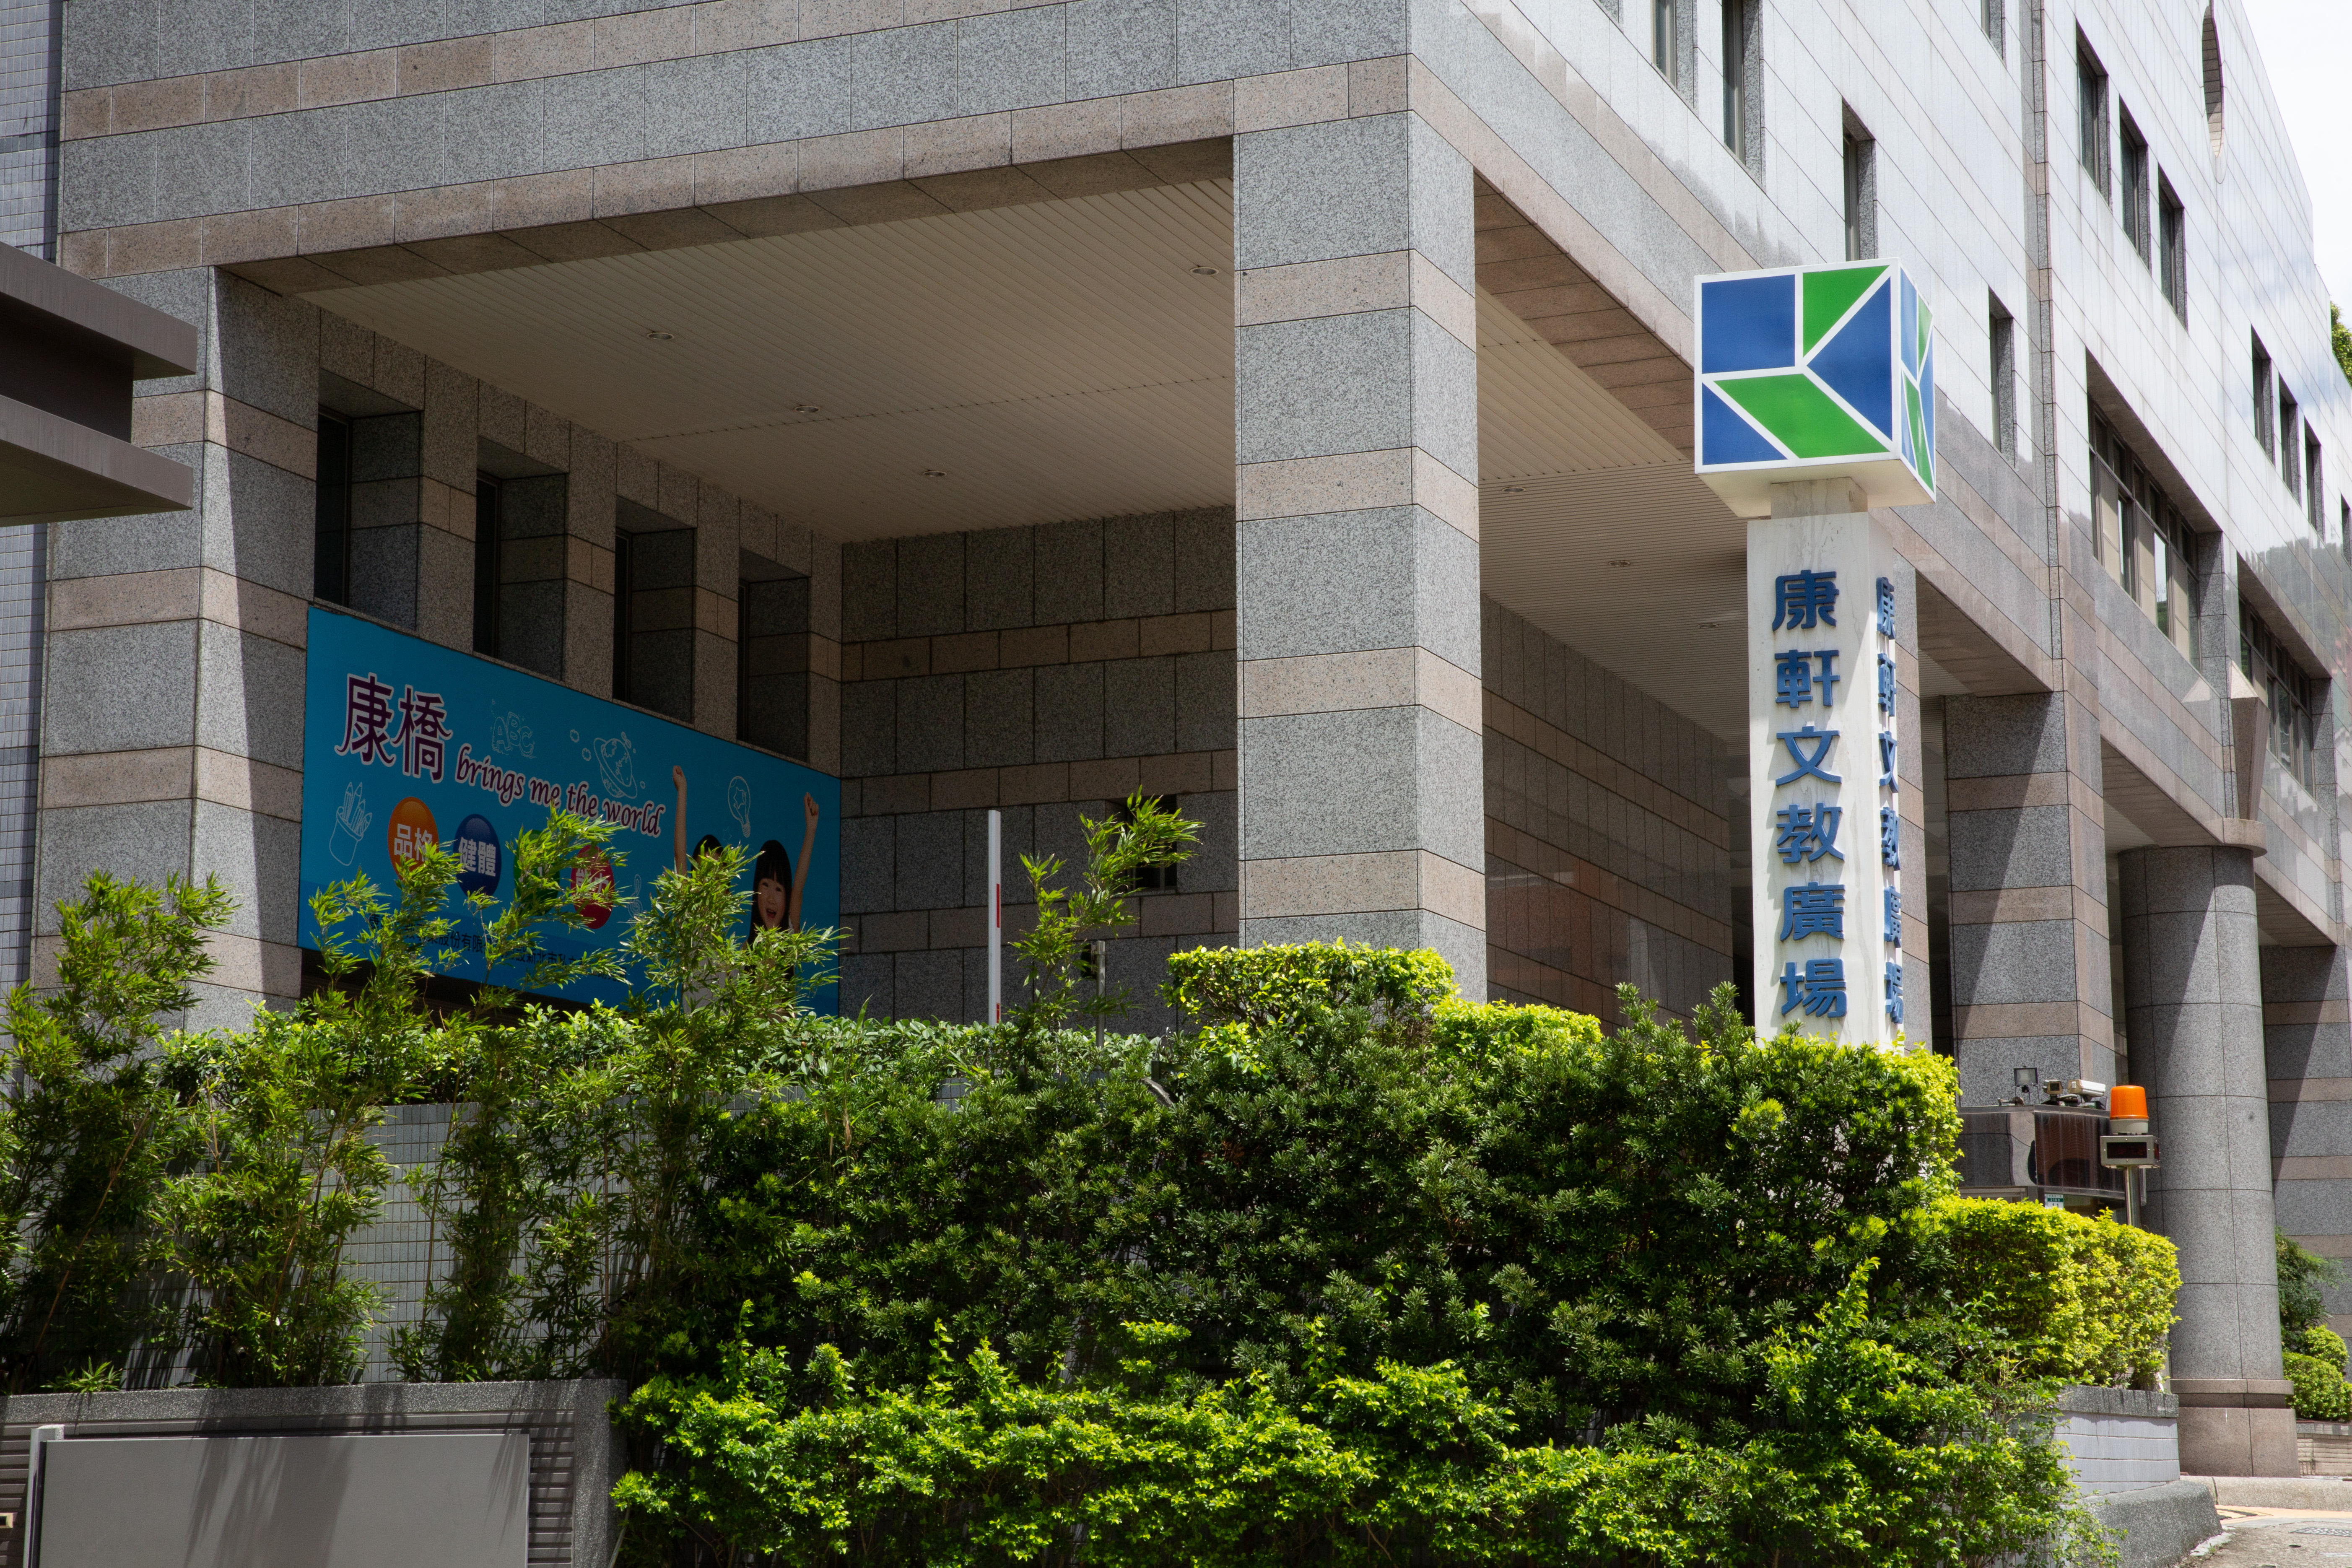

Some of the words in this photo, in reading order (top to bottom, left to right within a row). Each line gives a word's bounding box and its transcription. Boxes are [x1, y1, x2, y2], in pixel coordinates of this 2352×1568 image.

[335, 673, 452, 782] 康橋
[456, 745, 524, 805] brings
[530, 778, 561, 807] me
[567, 783, 597, 818] the
[603, 800, 665, 836] world
[1772, 569, 1847, 1018] 康軒文教廣場
[458, 836, 496, 877] 健體
